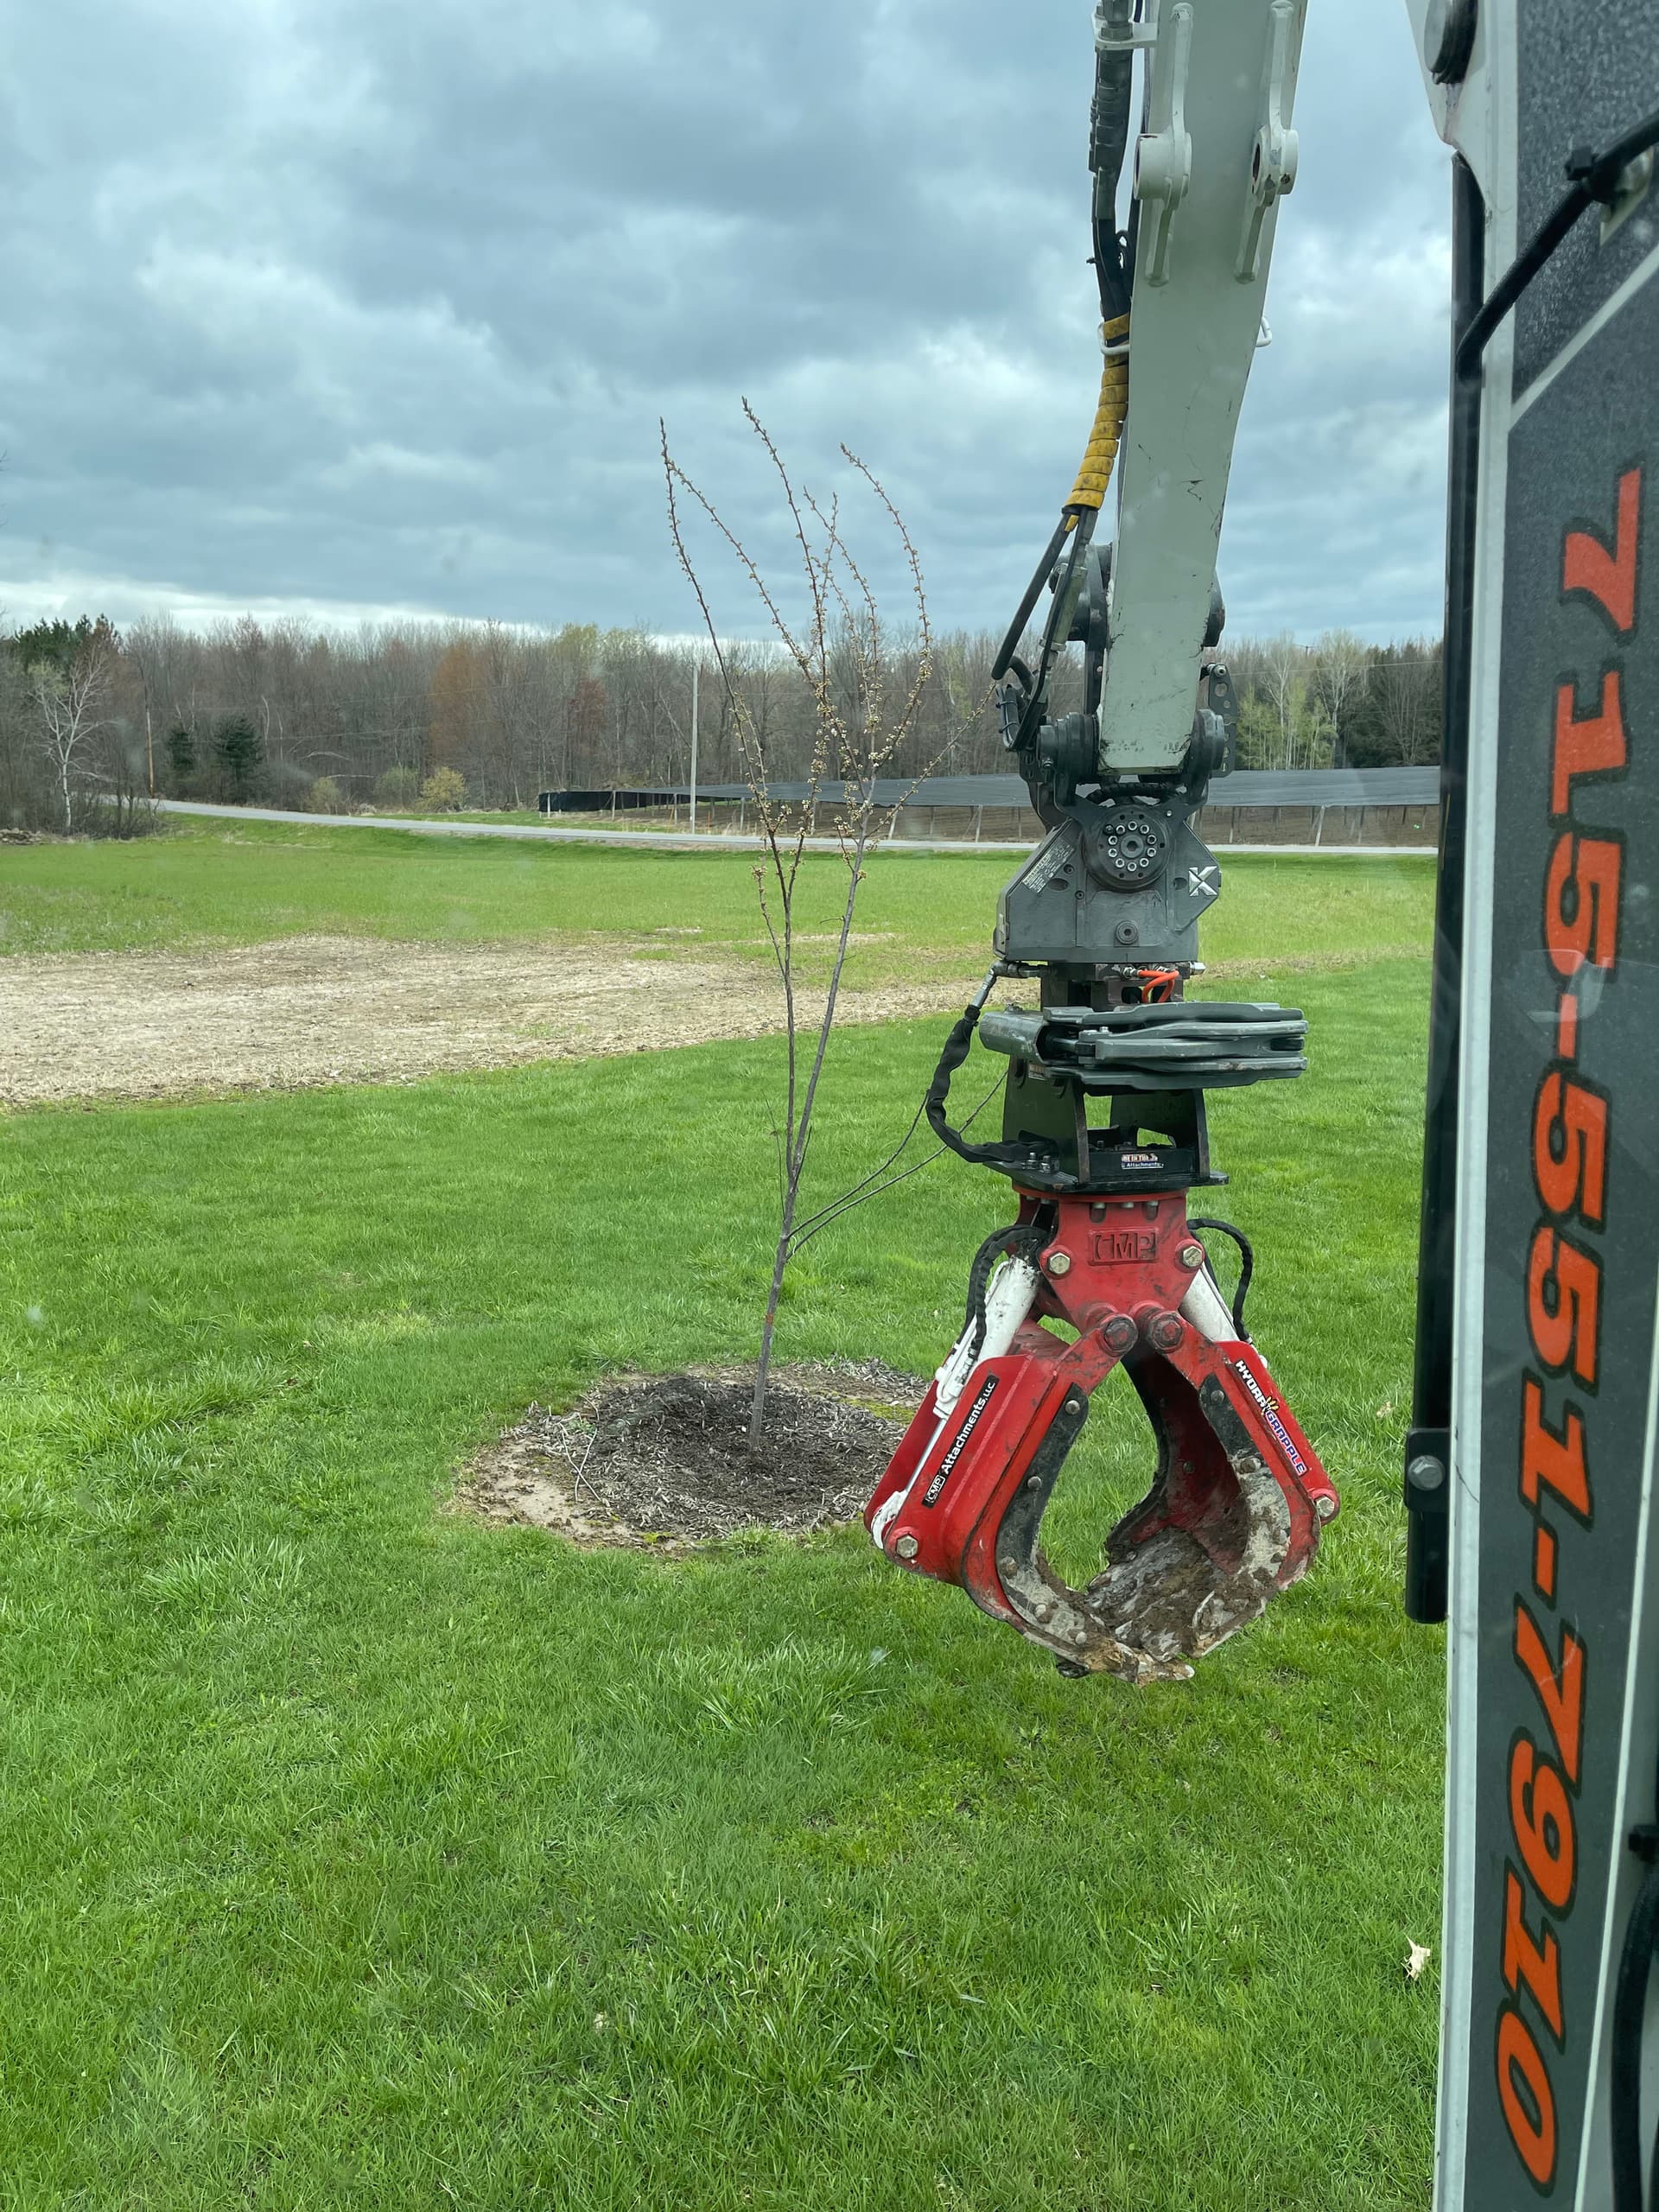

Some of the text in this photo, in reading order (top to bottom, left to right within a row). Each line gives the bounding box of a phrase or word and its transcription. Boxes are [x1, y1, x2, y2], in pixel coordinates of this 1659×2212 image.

[1094, 1231, 1157, 1261] CMP
[1498, 474, 1639, 2180] 715-551-7910
[1266, 1410, 1306, 1473] GRAPPLE
[927, 1478, 944, 1501] CMP
